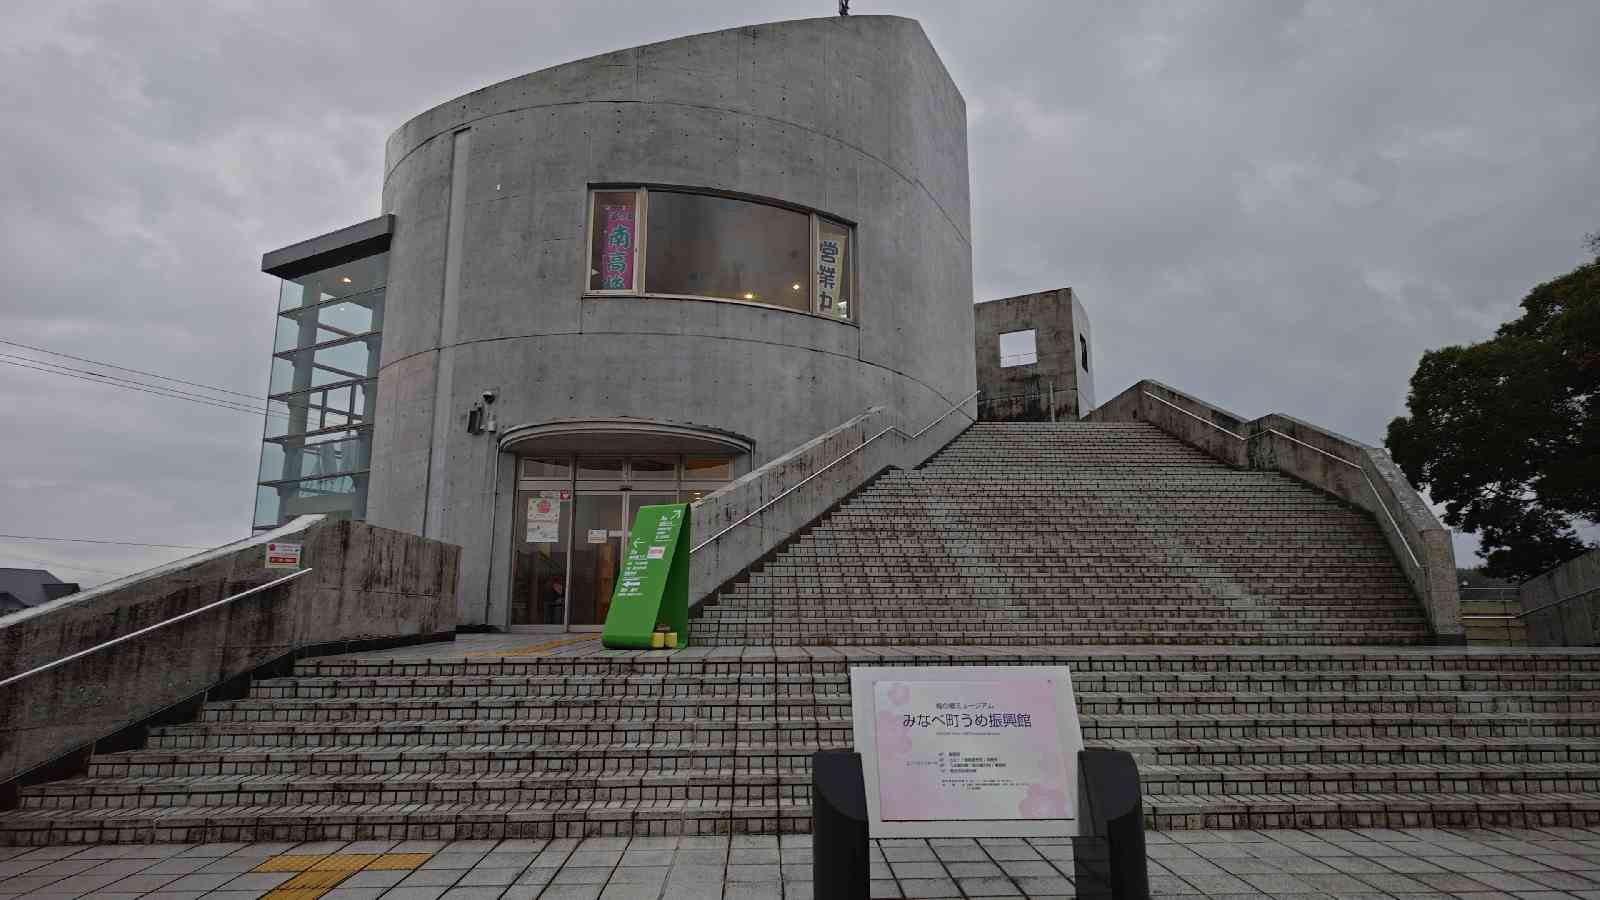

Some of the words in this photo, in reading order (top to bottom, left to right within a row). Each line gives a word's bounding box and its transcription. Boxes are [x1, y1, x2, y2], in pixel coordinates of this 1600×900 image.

[902, 712, 1032, 728] みなべ町うめ振興館
